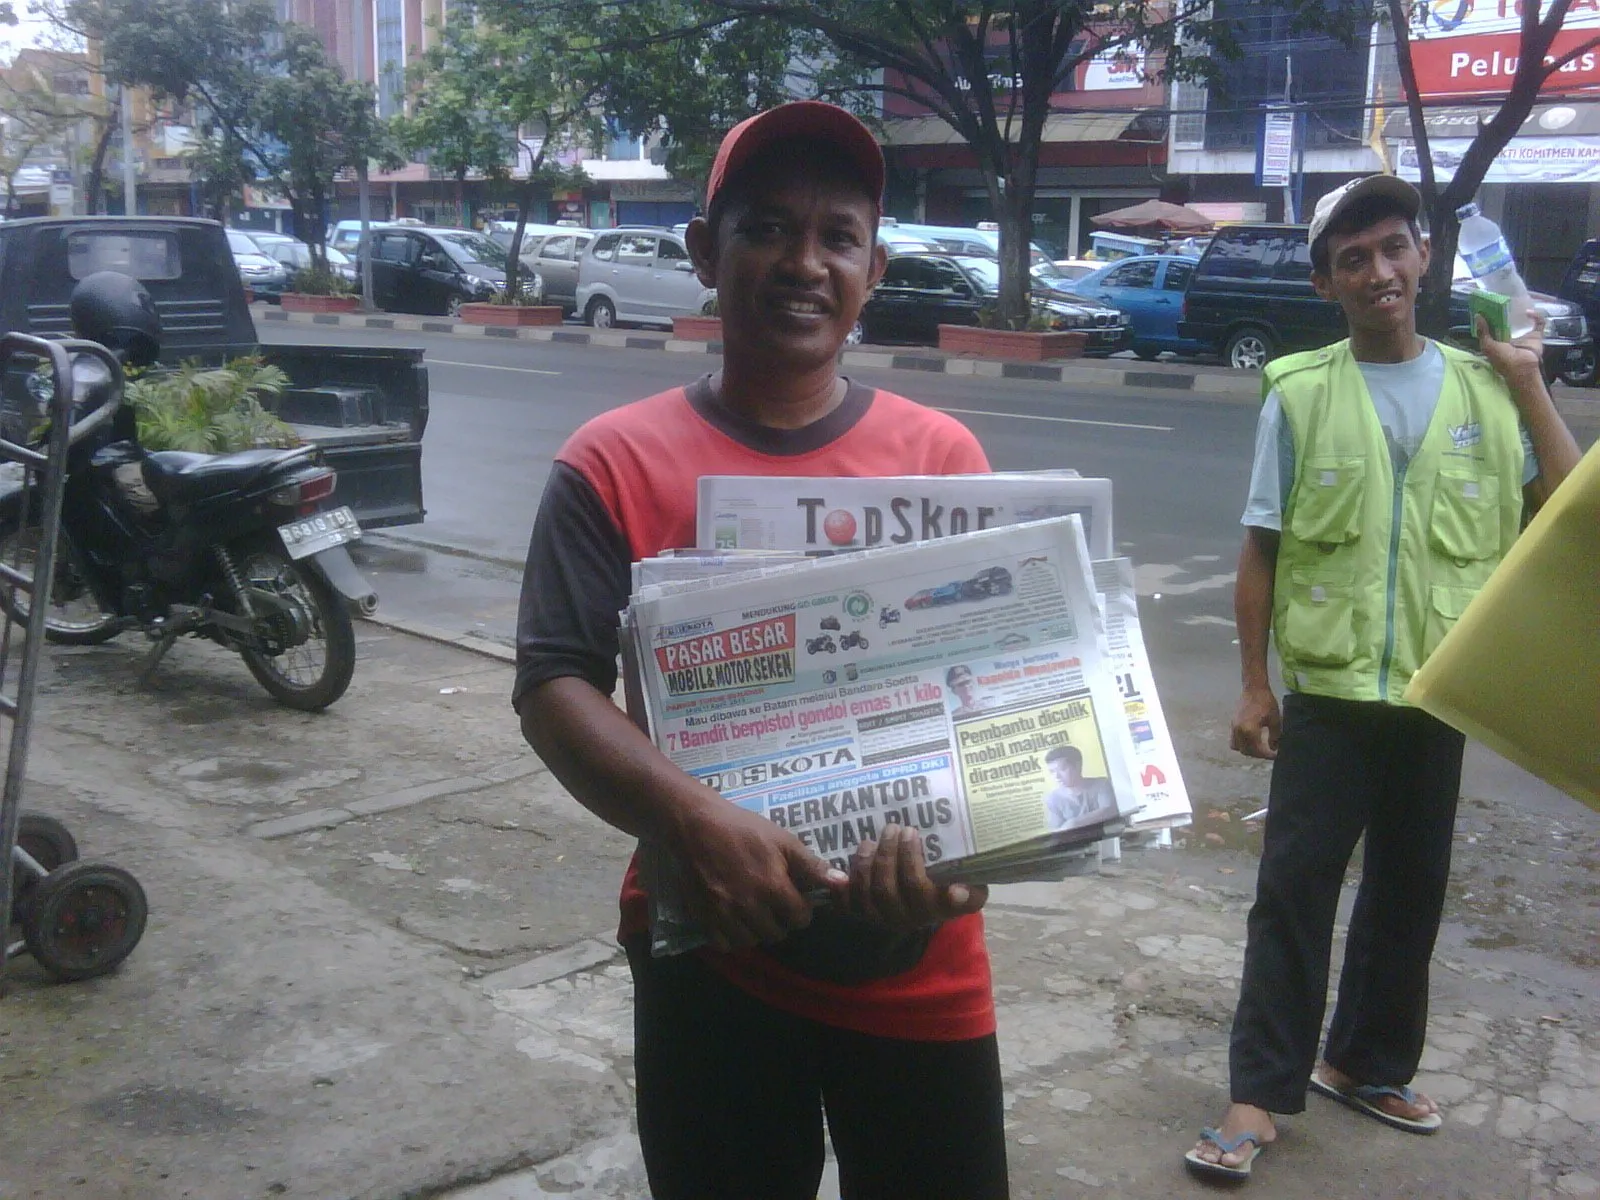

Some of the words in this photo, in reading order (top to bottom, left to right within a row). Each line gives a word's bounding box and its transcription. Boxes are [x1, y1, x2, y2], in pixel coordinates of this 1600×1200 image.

[1451, 52, 1595, 77] Peluas
[1519, 148, 1575, 159] KOMITMEN
[742, 602, 796, 620] MENDUKUNG
[666, 635, 727, 669] PASAR
[729, 621, 789, 655] BESAR
[668, 670, 706, 694] MOBIL
[715, 660, 753, 687] MOTOR
[754, 652, 793, 680] SEKEN
[666, 733, 676, 751] 7
[680, 721, 729, 749] Bandit
[731, 710, 796, 740] berpistol
[799, 700, 848, 731] gondol
[850, 694, 892, 716] emas
[894, 687, 911, 707] 11
[915, 681, 942, 701] kilo
[685, 715, 708, 728] Mau
[710, 707, 741, 723] dibawa
[763, 699, 798, 713] Batam
[800, 690, 838, 706] melalui
[838, 681, 883, 699] Bandara
[960, 717, 1037, 747] Pembantu
[1038, 701, 1090, 728] diculik
[964, 742, 1006, 765] mobil
[1008, 729, 1070, 754] majikan
[701, 748, 856, 792] POSKOTA
[772, 782, 824, 803] Fasilitas
[828, 773, 880, 789] anggota
[882, 763, 918, 779] DPRD
[921, 758, 945, 771] DKI
[969, 756, 1043, 784] dirampok
[769, 775, 930, 829] BERKANTOR
[797, 815, 878, 852] EWAH
